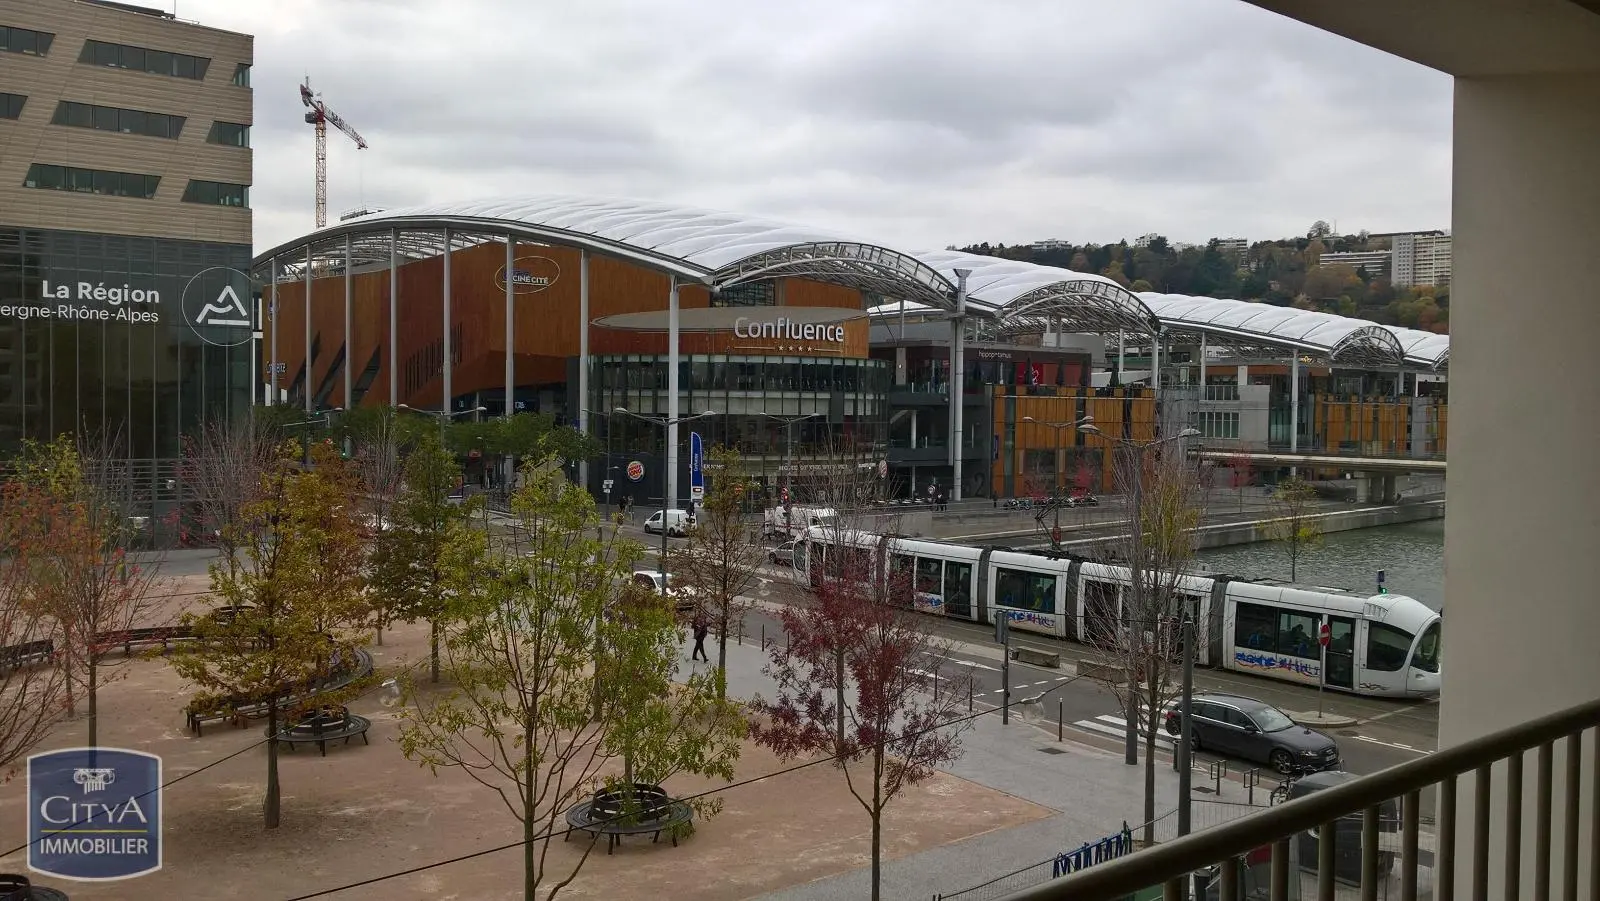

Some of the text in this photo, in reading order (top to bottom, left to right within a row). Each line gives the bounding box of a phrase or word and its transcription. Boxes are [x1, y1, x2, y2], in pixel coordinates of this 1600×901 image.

[42, 280, 160, 305] La Région
[0, 305, 159, 324] ergne-Rhône-Alpes
[734, 316, 844, 342] Confluence
